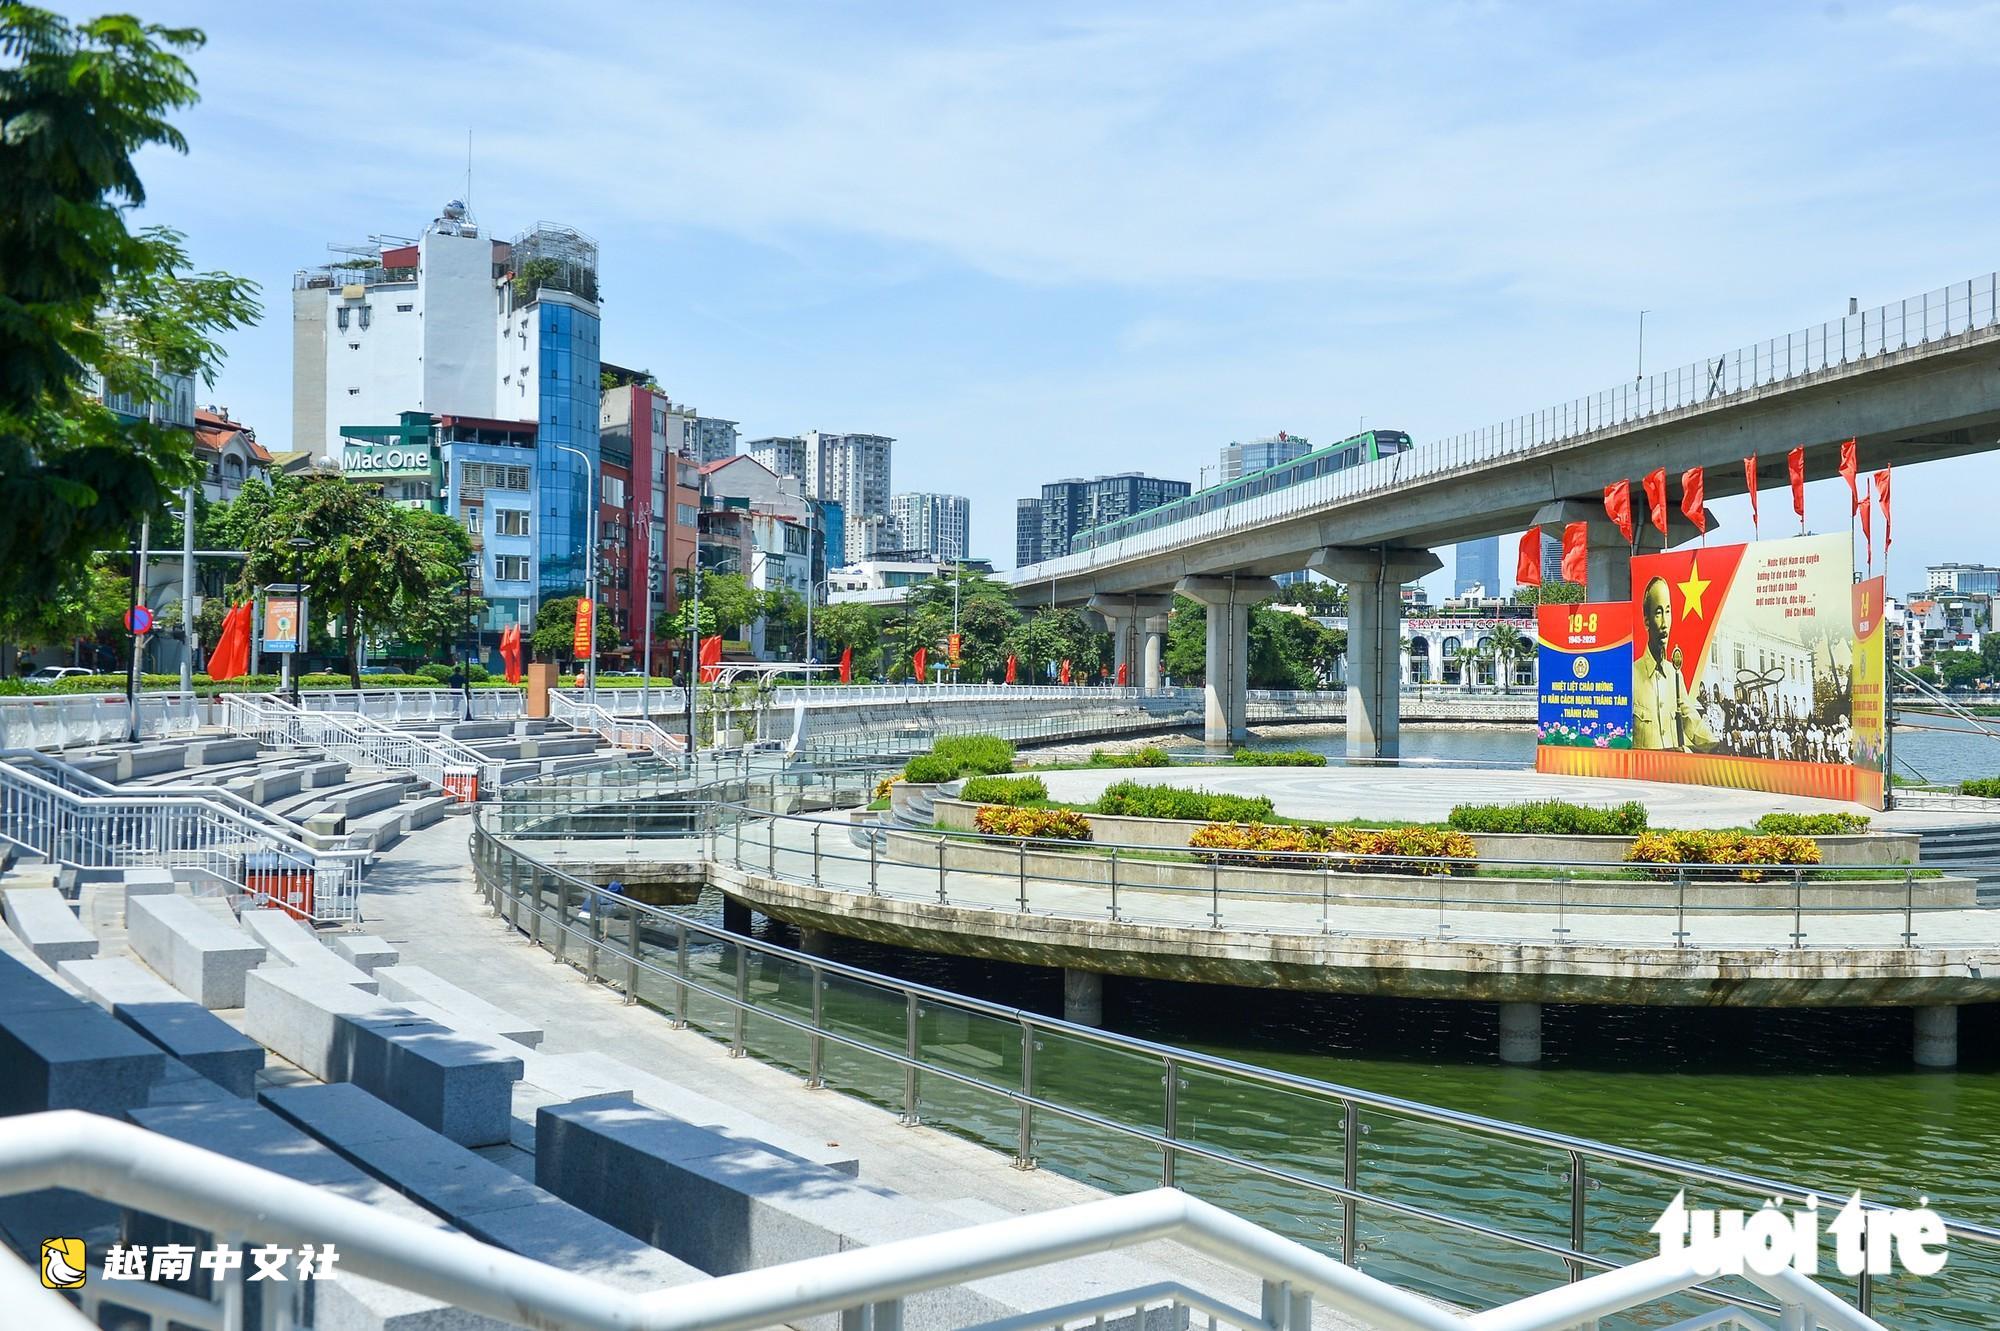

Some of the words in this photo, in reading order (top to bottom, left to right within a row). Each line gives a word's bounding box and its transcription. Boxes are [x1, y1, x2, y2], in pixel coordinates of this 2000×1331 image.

[344, 451, 384, 470] Mac
[387, 449, 428, 469] One
[1408, 619, 1471, 629] SKYLINE
[1568, 613, 1598, 633] 19-8
